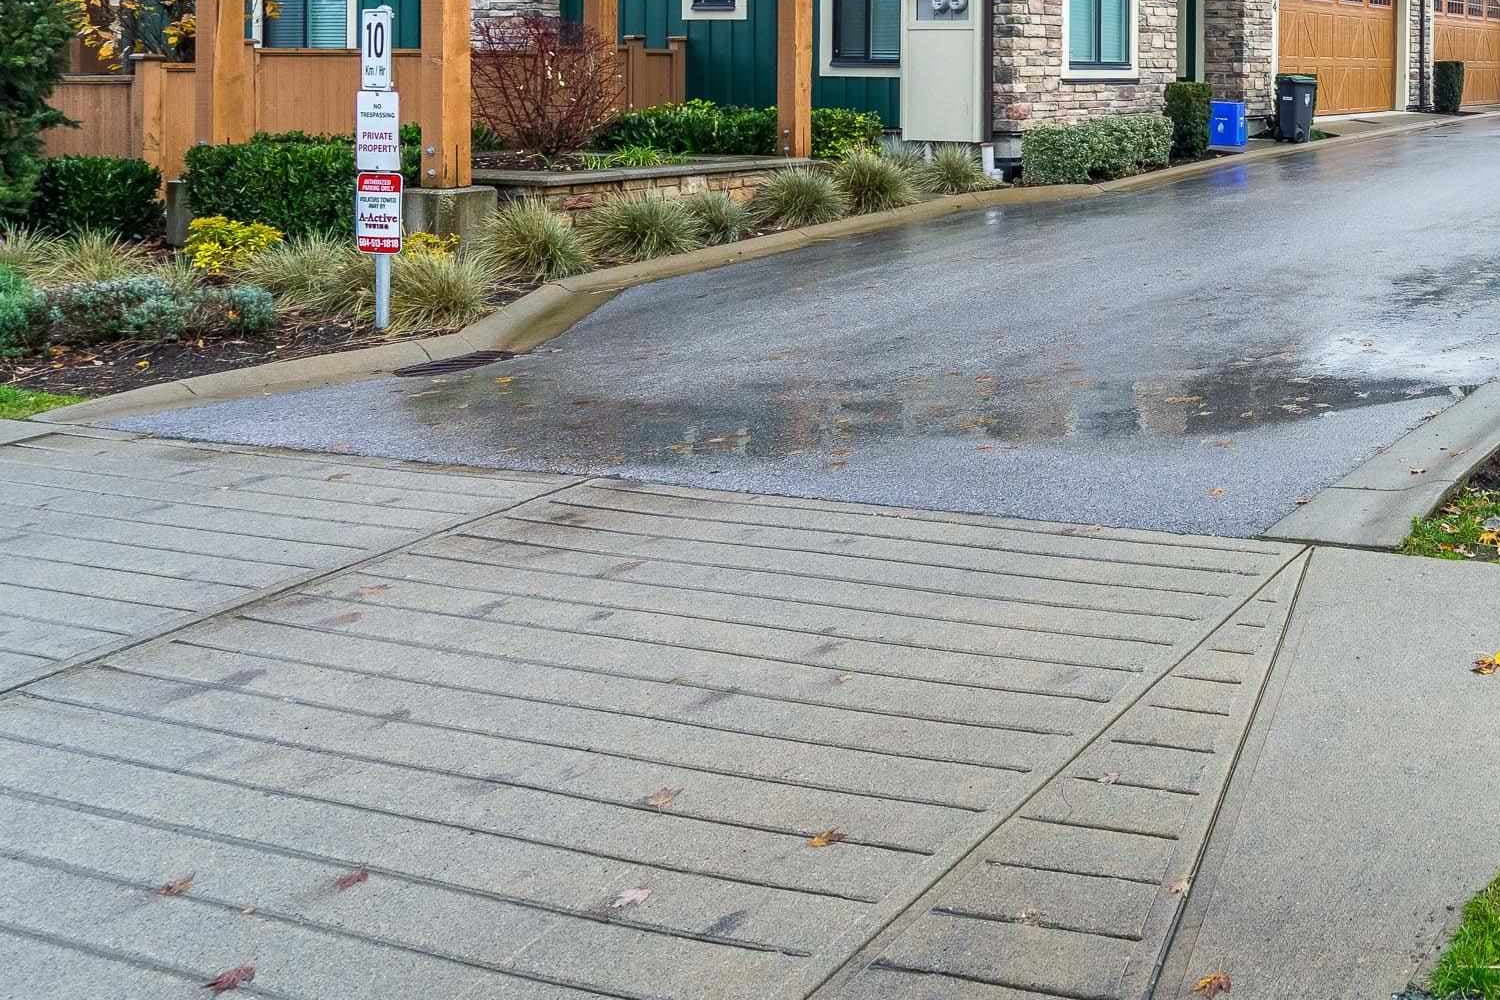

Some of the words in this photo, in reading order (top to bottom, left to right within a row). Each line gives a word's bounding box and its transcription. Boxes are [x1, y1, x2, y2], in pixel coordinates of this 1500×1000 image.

[366, 22, 385, 58] 10
[360, 111, 396, 119] TRESPASSING
[362, 131, 393, 141] PRIVATE
[358, 144, 397, 153] PROPERTY
[359, 212, 398, 223] A-Active
